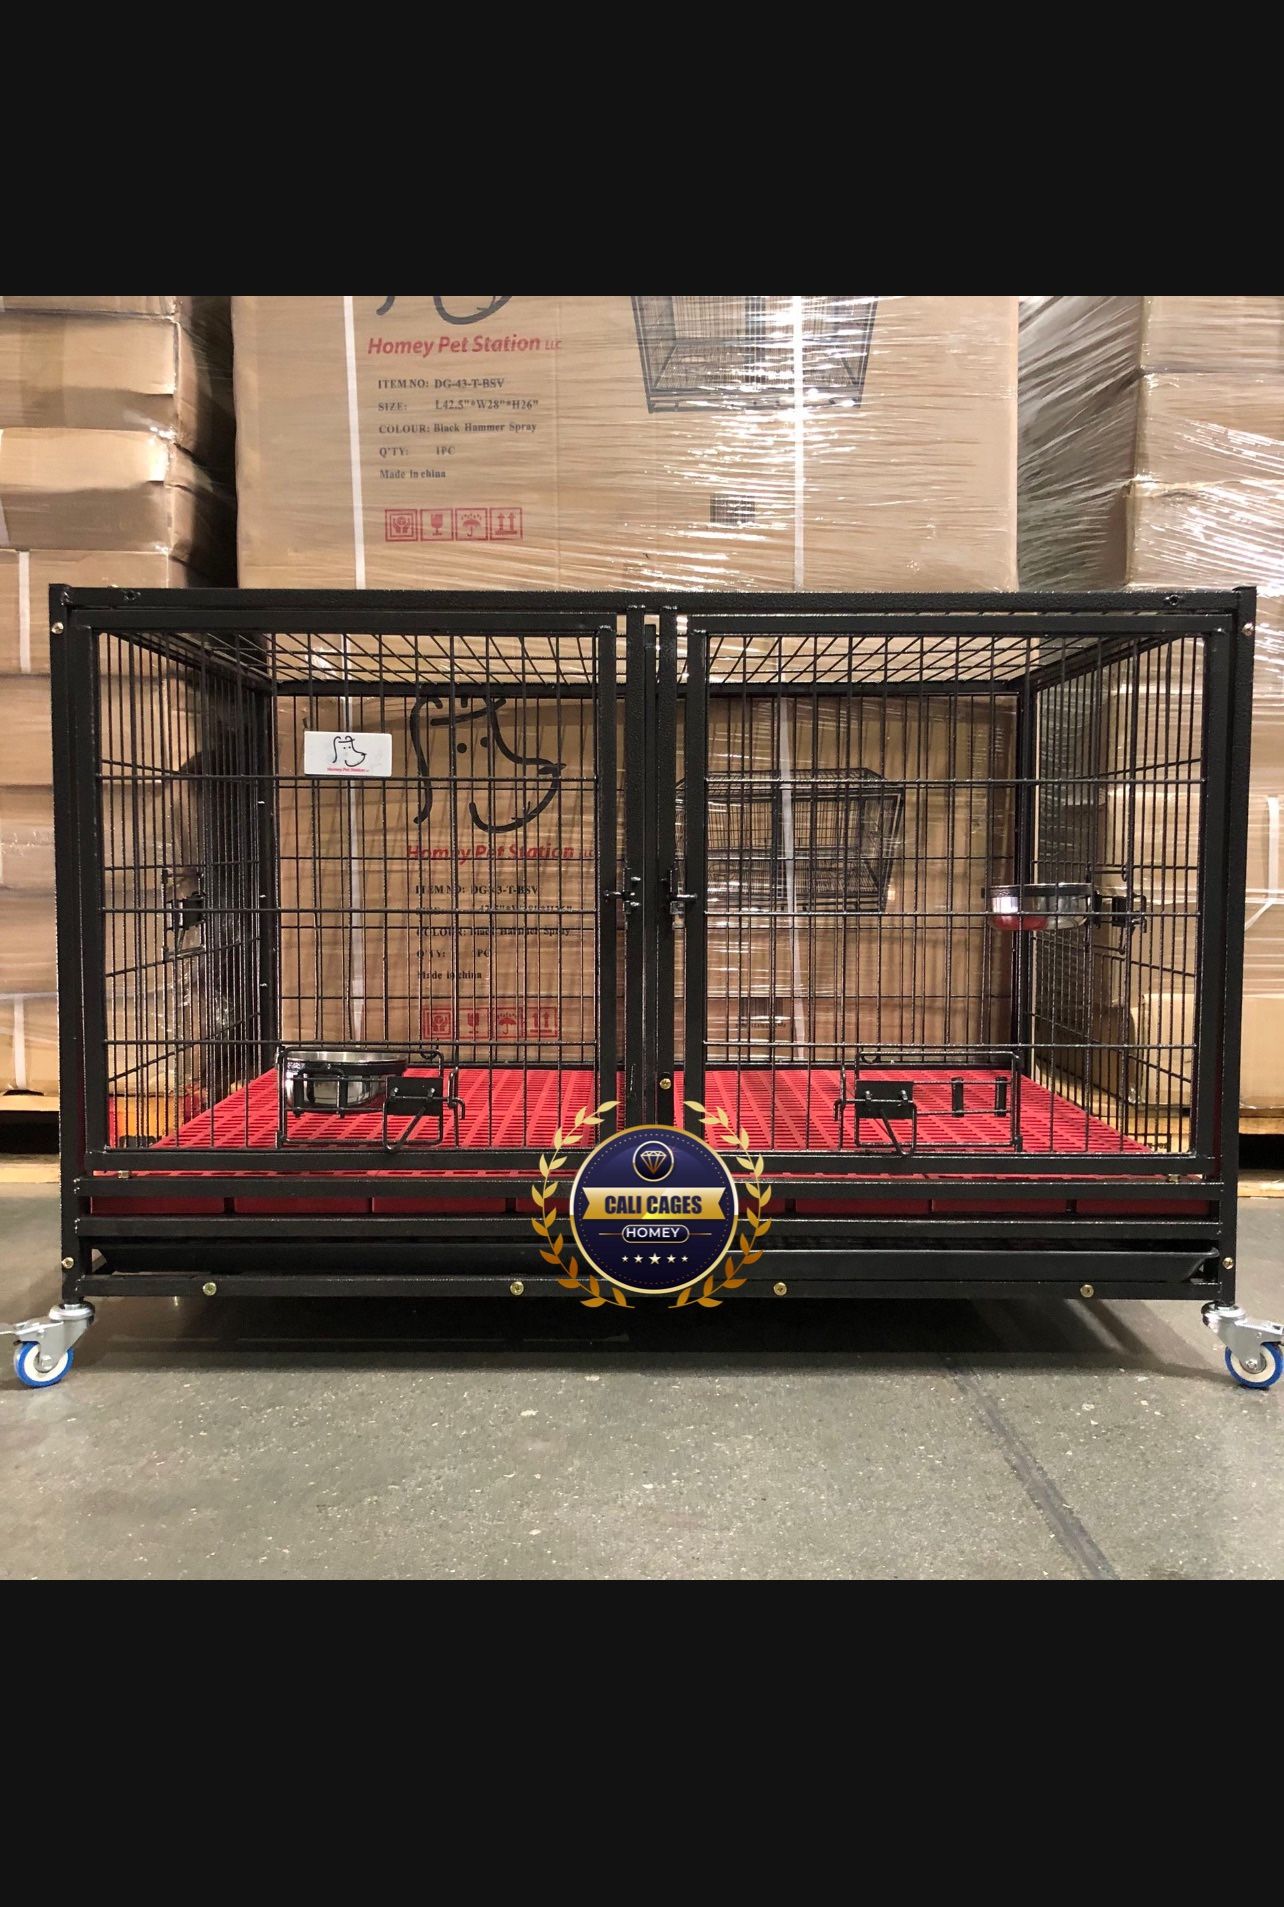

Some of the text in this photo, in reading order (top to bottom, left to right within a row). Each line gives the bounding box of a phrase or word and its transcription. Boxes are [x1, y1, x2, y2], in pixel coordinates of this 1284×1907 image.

[367, 333, 562, 358] Homey Pet Station LLC
[378, 377, 505, 389] ITEM NO: DG-43-T-BSV
[377, 402, 408, 411] SIZE:
[378, 422, 537, 434] COLOUR: Black Hammer Spray
[380, 469, 406, 479] Made
[420, 468, 446, 478] china
